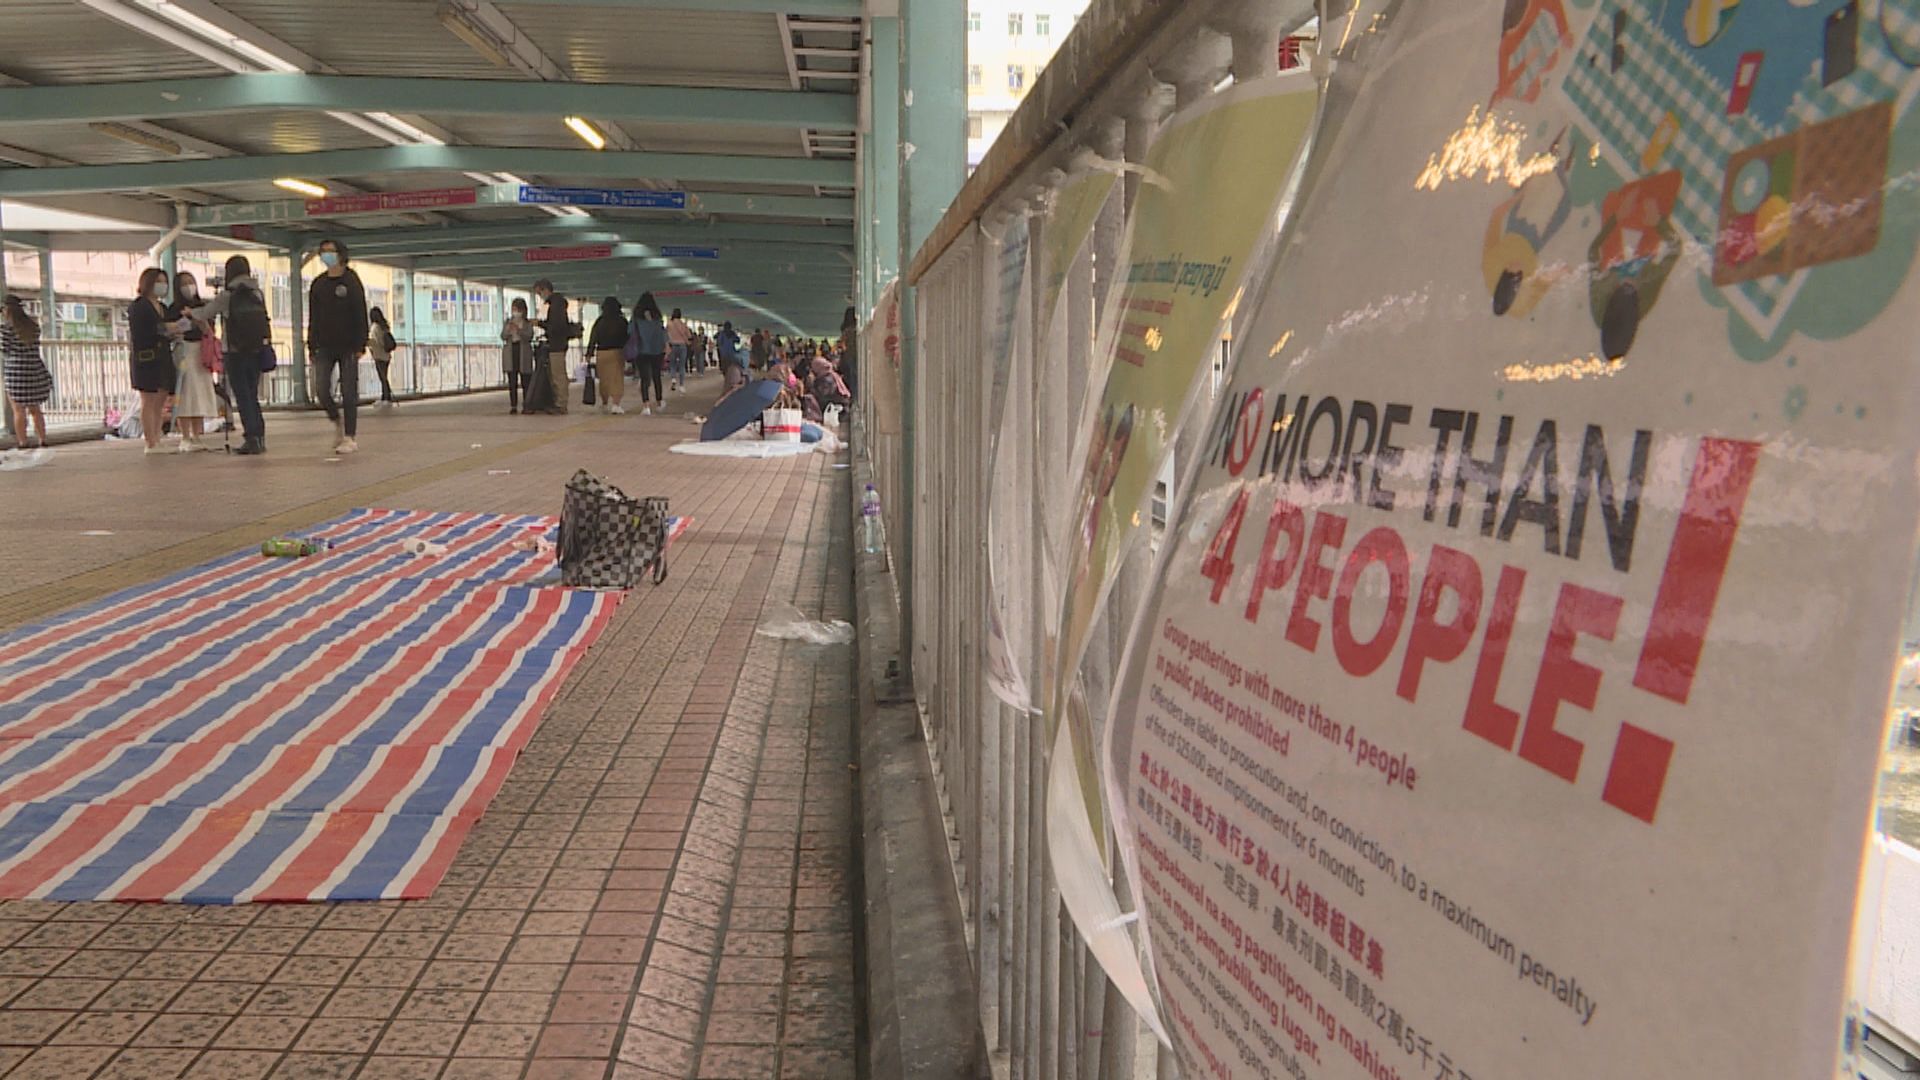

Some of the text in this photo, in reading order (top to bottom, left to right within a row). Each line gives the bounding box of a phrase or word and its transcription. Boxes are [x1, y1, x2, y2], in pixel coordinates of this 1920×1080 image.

[1201, 487, 1251, 606] 4
[1210, 387, 1653, 573] NO MORE THAN
[1156, 648, 1291, 757] in public places prohibited
[1162, 617, 1417, 790] Group gatherings with more than 4 people
[1145, 713, 1155, 730] of
[1153, 716, 1168, 743] fine
[1167, 730, 1178, 753] of
[1206, 762, 1224, 788] and
[1224, 775, 1292, 841] imprisonment
[1291, 820, 1309, 851] for
[1308, 837, 1318, 859] 6
[1318, 849, 1366, 898] months
[1183, 711, 1196, 732] are
[1197, 717, 1219, 749] liable
[1219, 735, 1229, 756] to
[1229, 747, 1286, 797] prosecution
[1286, 785, 1310, 819] and,
[1312, 804, 1328, 829] on
[1330, 815, 1398, 883] conviction,
[1401, 863, 1416, 893] to
[1419, 881, 1427, 901] a
[1431, 888, 1516, 965] maximum
[1518, 952, 1598, 1027] penalty
[1162, 887, 1172, 909] sa
[1173, 899, 1194, 934] mga
[1196, 922, 1279, 1027] pampublikong
[1281, 1003, 1322, 1067] lugar.
[1205, 895, 1219, 922] na
[1220, 910, 1242, 950] ang
[1244, 934, 1314, 1015] pagtitipon
[1316, 1002, 1336, 1041] ng
[1338, 1022, 1402, 1080] mahig
